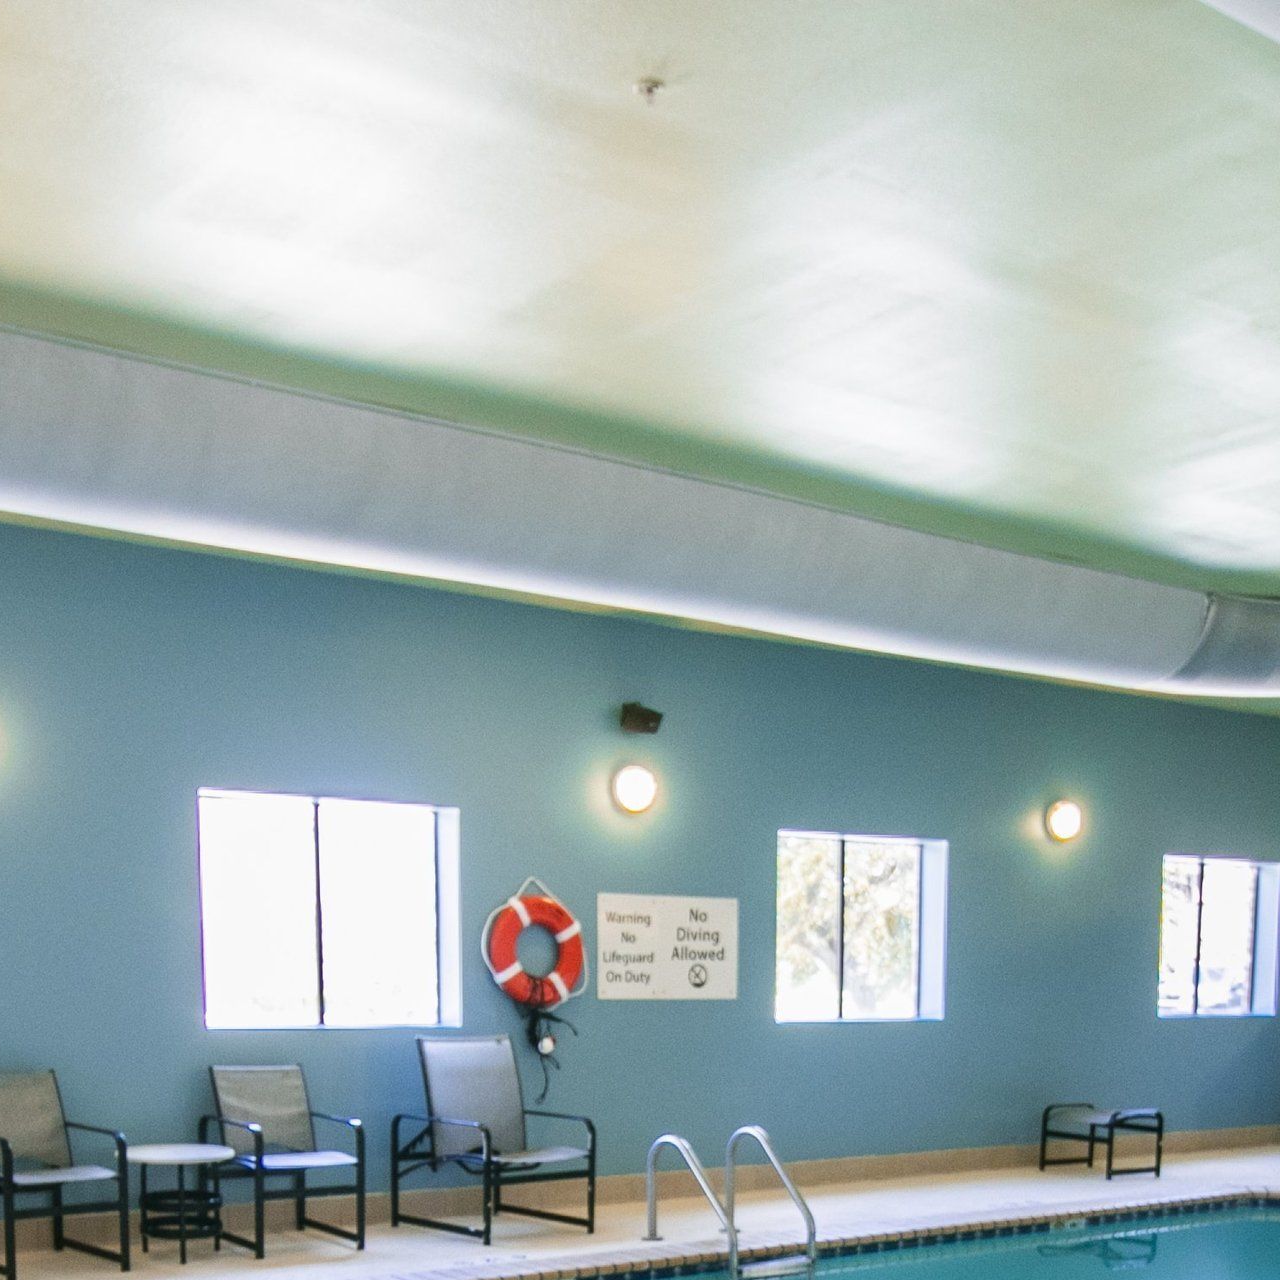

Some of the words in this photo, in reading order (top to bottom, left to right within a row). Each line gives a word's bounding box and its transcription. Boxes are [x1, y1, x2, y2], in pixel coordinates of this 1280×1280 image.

[606, 911, 651, 927] Warning
[689, 909, 708, 922] No
[620, 932, 636, 943] No
[676, 927, 720, 946] Diving
[602, 951, 655, 966] Lifeguard
[671, 947, 725, 961] Allowed
[606, 971, 621, 983] On
[624, 971, 651, 985] Duty
